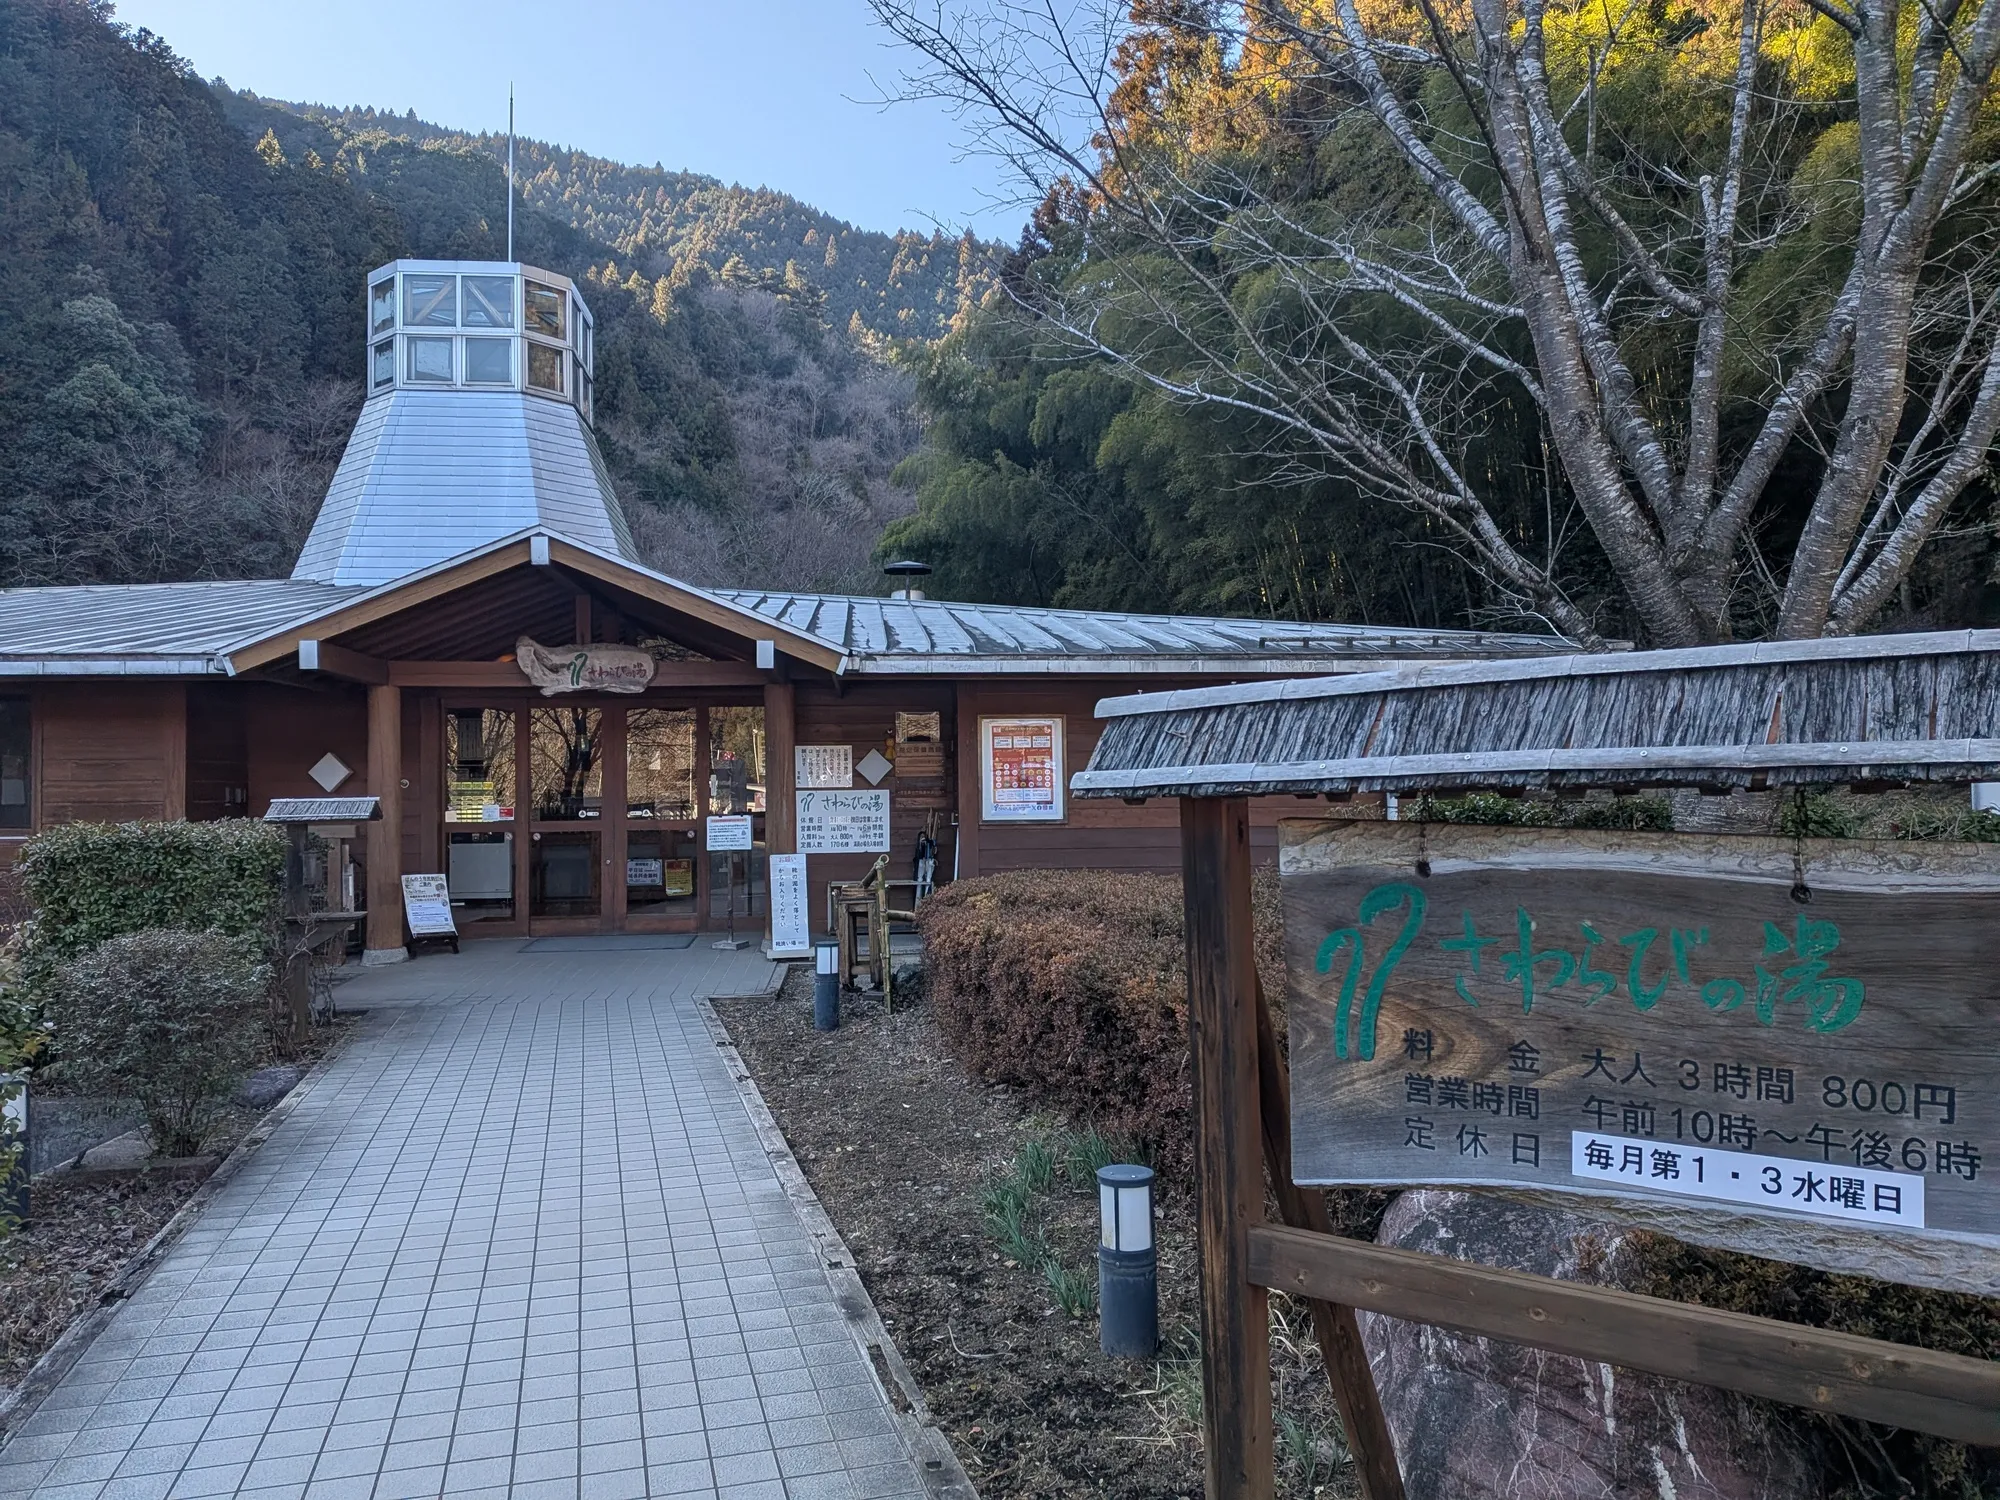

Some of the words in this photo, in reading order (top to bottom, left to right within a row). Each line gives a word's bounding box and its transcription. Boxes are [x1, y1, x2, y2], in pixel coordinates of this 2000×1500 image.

[586, 663, 647, 679] さわらびの湯
[820, 793, 884, 813] さわらびの湯
[778, 868, 786, 928] からお入りください
[791, 867, 800, 934] 靴の泥をよく落として
[1440, 905, 1866, 1033] さわらびの湯
[1404, 1071, 1540, 1120] 営業時間
[1822, 1075, 1956, 1125] 800円
[1584, 1139, 1902, 1215] 毎月第1・3水曜日
